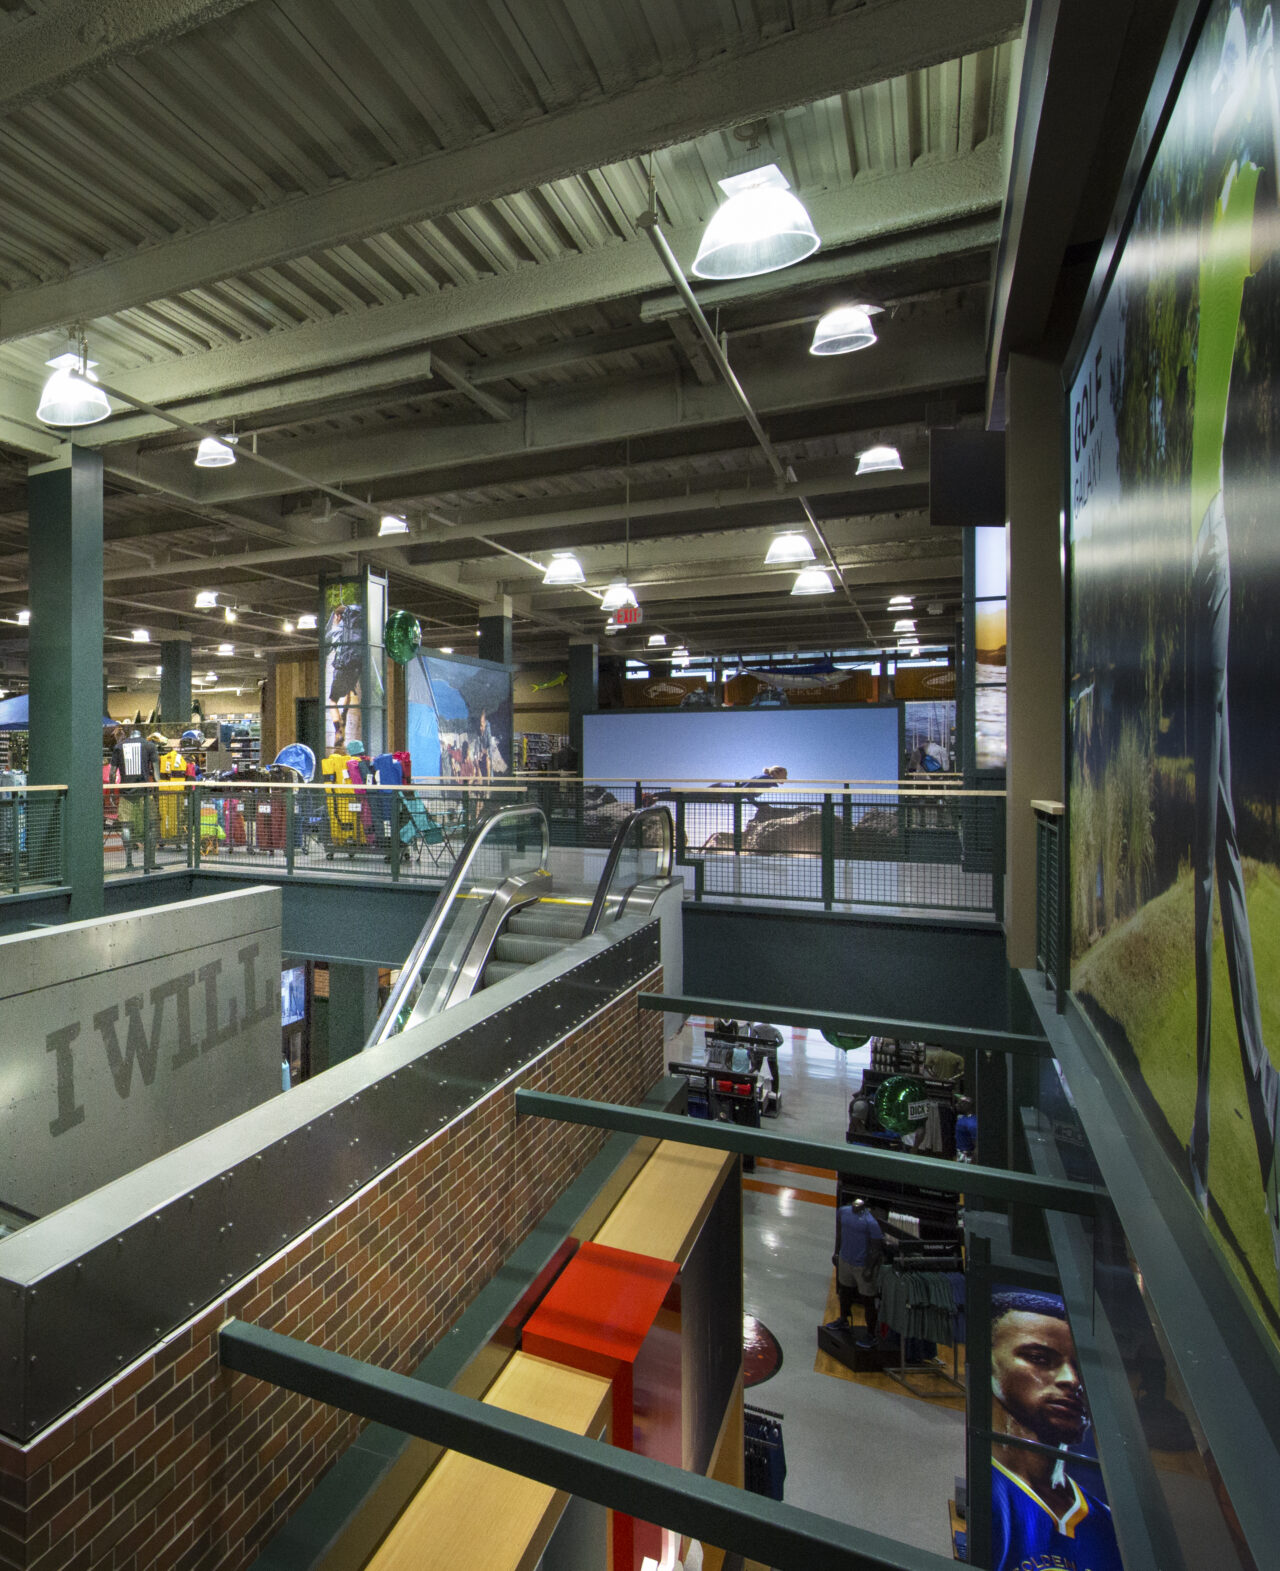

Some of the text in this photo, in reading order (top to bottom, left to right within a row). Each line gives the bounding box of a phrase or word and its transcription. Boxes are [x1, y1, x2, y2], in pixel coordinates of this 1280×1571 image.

[1074, 346, 1102, 463] GOLF
[1074, 432, 1103, 519] GALAXY
[617, 608, 638, 624] EXIT
[46, 1021, 85, 1138] I
[1012, 1554, 1076, 1571] OLDEN
